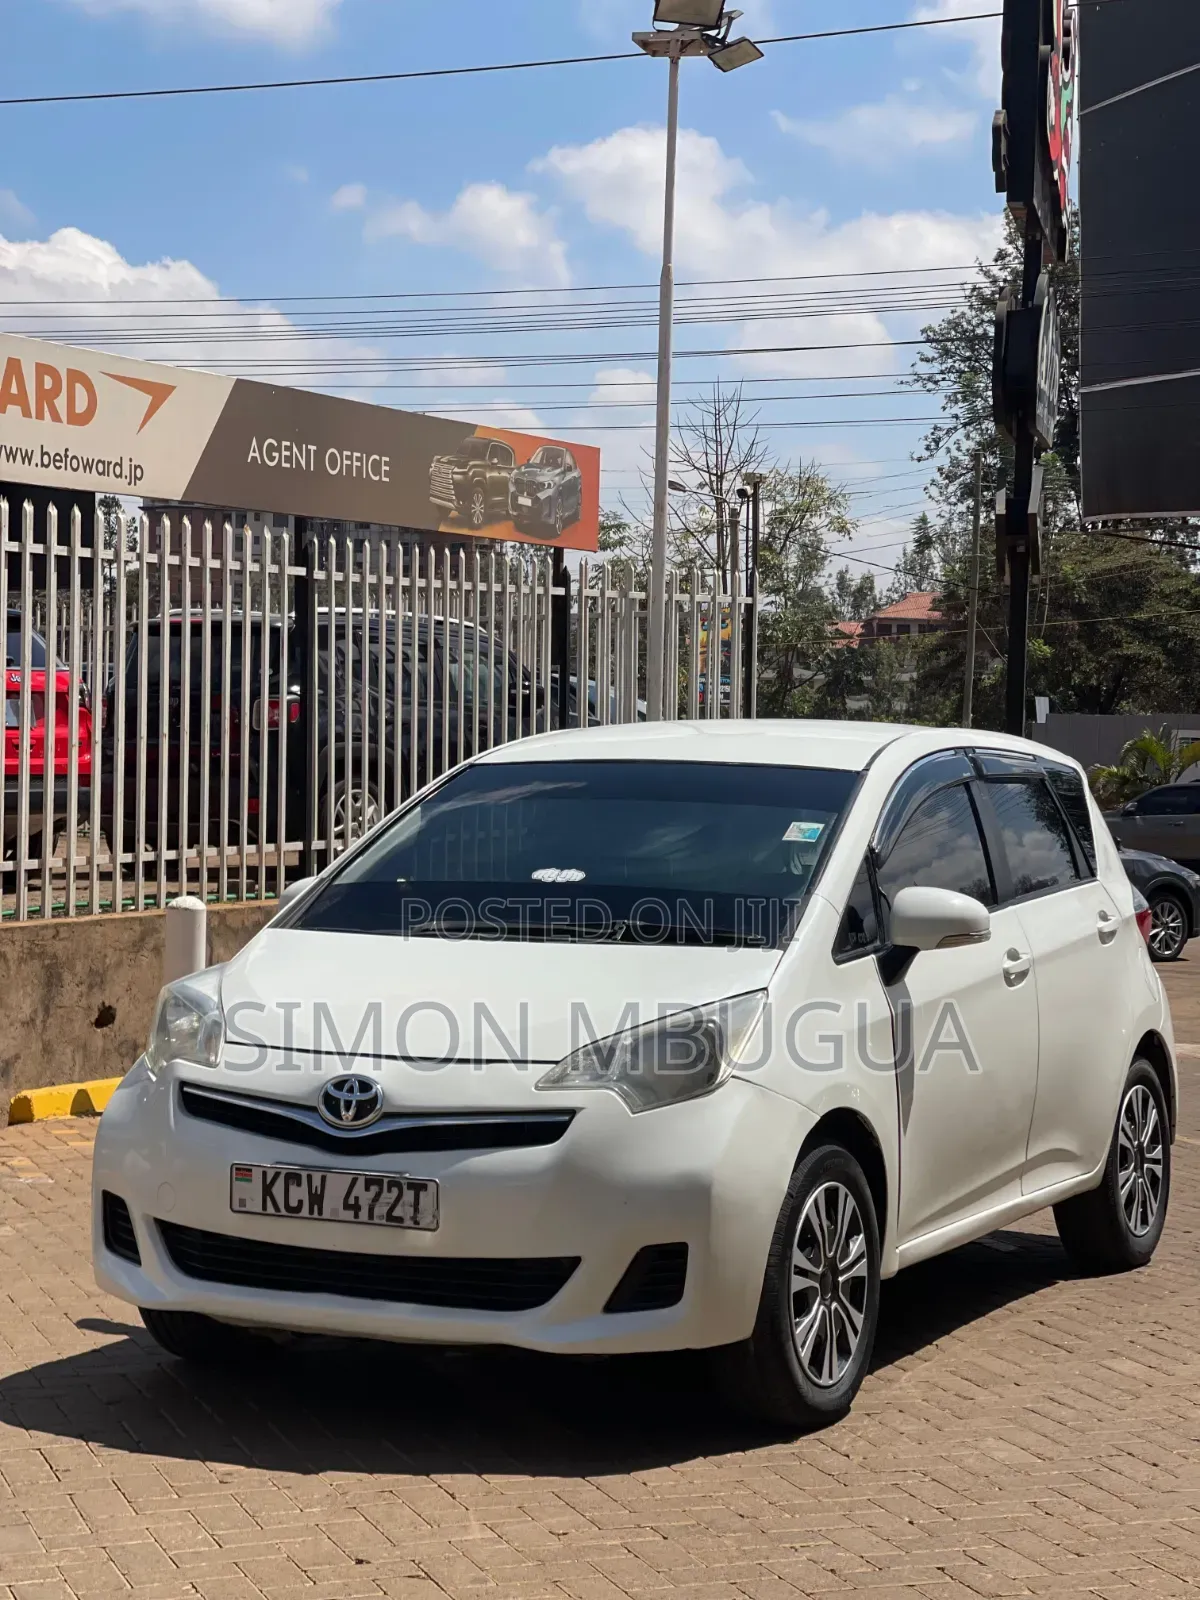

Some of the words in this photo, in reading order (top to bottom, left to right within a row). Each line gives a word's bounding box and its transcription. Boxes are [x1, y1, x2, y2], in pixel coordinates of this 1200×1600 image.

[0, 444, 144, 486] ww.befoward.jp
[247, 436, 317, 472] AGENT
[325, 447, 390, 482] OFFICE
[261, 1170, 327, 1216] KCW
[342, 1176, 428, 1225] 472T
